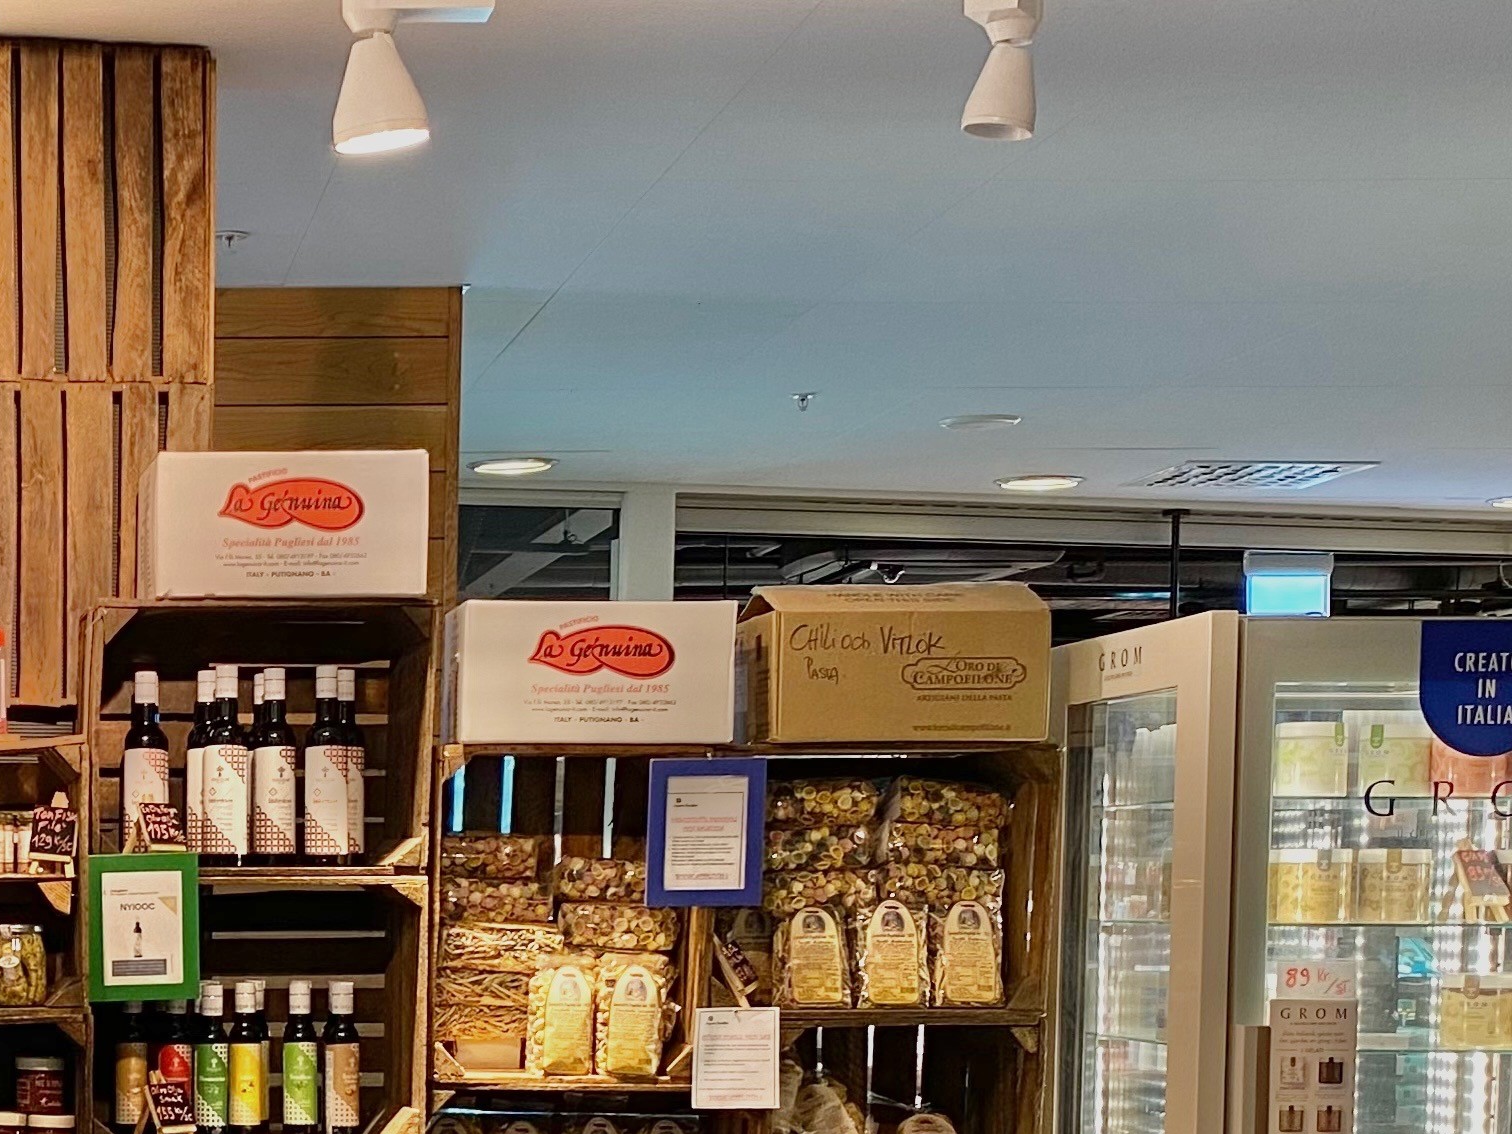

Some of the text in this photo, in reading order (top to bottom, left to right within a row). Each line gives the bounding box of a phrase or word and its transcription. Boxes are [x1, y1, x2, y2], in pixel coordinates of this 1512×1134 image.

[317, 537, 333, 547] dal
[335, 536, 360, 547] 1985
[1098, 646, 1143, 671] GROM
[627, 684, 643, 693] dal
[645, 684, 669, 693] 1985
[1478, 679, 1496, 699] IN
[1280, 1007, 1347, 1020] GROM
